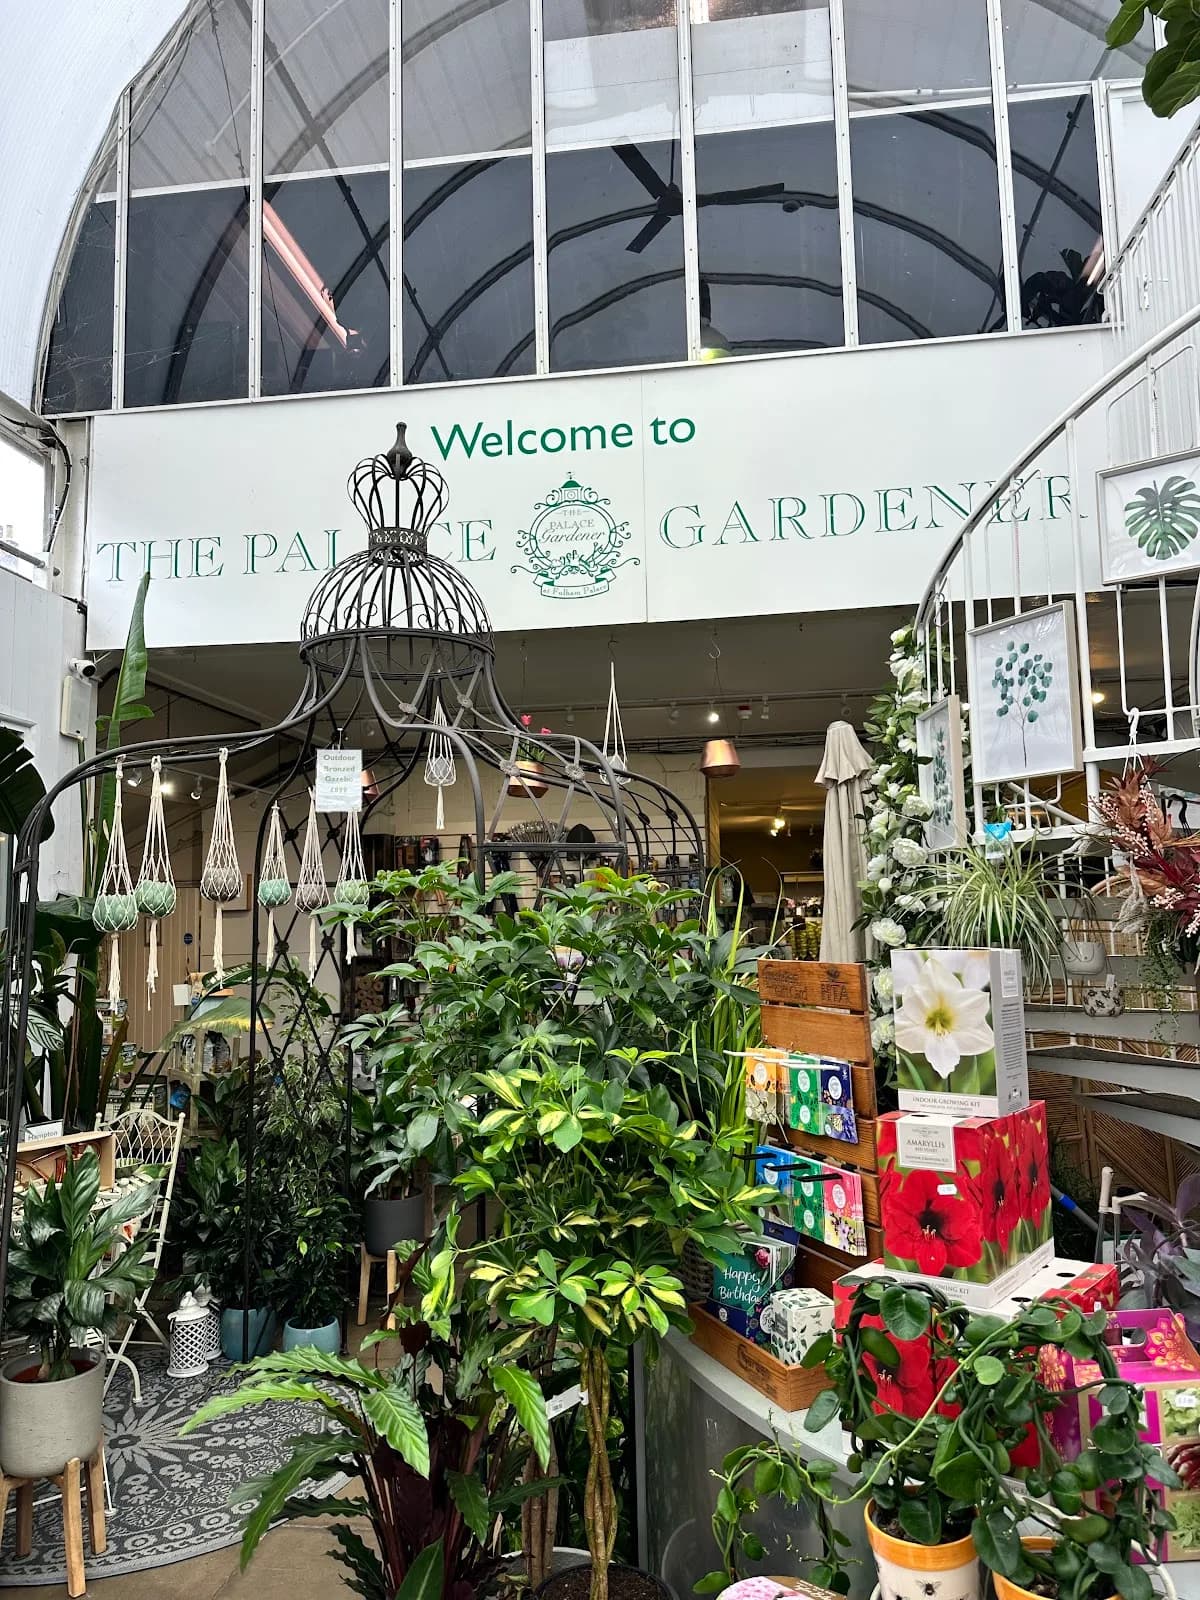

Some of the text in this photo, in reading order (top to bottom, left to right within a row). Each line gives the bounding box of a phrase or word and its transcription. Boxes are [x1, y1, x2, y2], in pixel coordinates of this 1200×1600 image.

[430, 416, 696, 461] Welcome to
[562, 509, 584, 517] THE
[659, 475, 1089, 549] GARDENER
[549, 519, 595, 530] PALACE
[538, 526, 605, 543] Gardener
[96, 519, 497, 582] THE PALCE
[552, 586, 581, 596] Fulham
[582, 584, 607, 595] Palace
[906, 1139, 945, 1149] AMARYLLIS
[723, 1265, 761, 1293] Happy
[718, 1286, 760, 1304] Birthda
